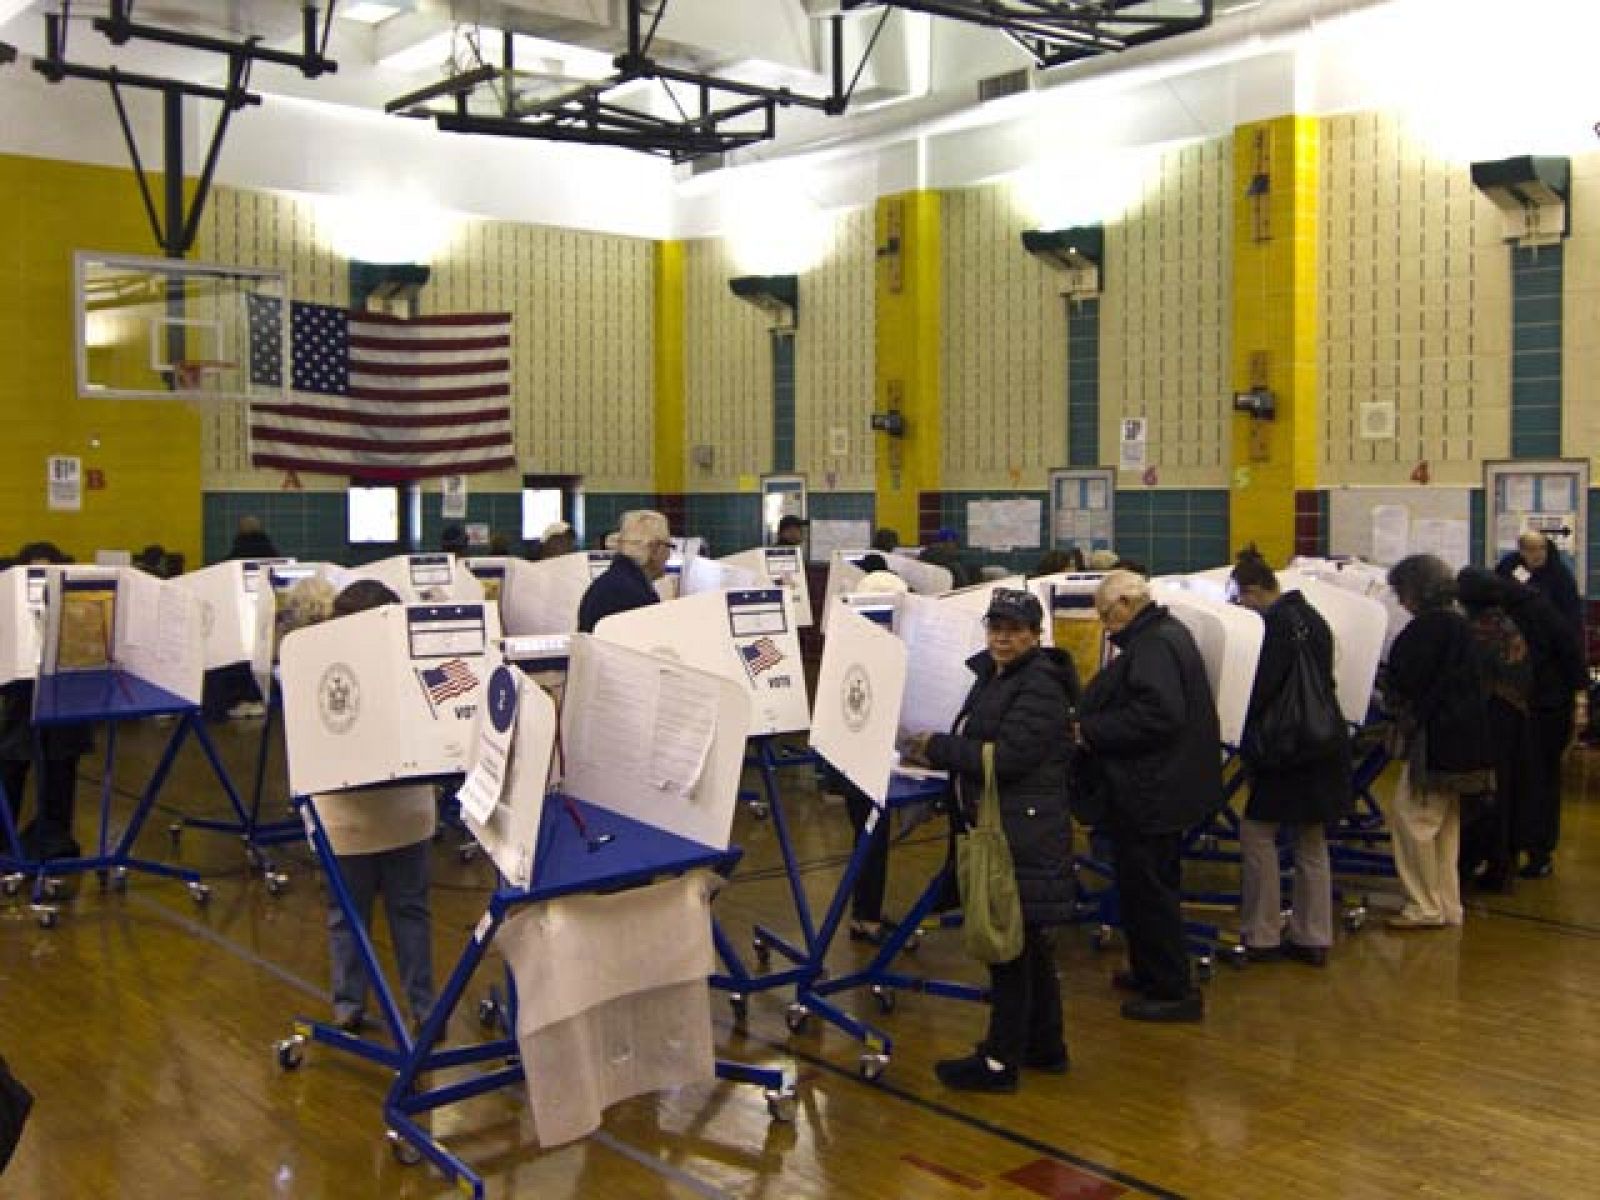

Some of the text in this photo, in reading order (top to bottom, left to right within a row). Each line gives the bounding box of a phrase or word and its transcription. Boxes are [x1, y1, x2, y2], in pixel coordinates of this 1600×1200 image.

[87, 469, 105, 490] B
[281, 470, 304, 489] A
[1142, 464, 1158, 486] 6
[1410, 461, 1430, 485] 4
